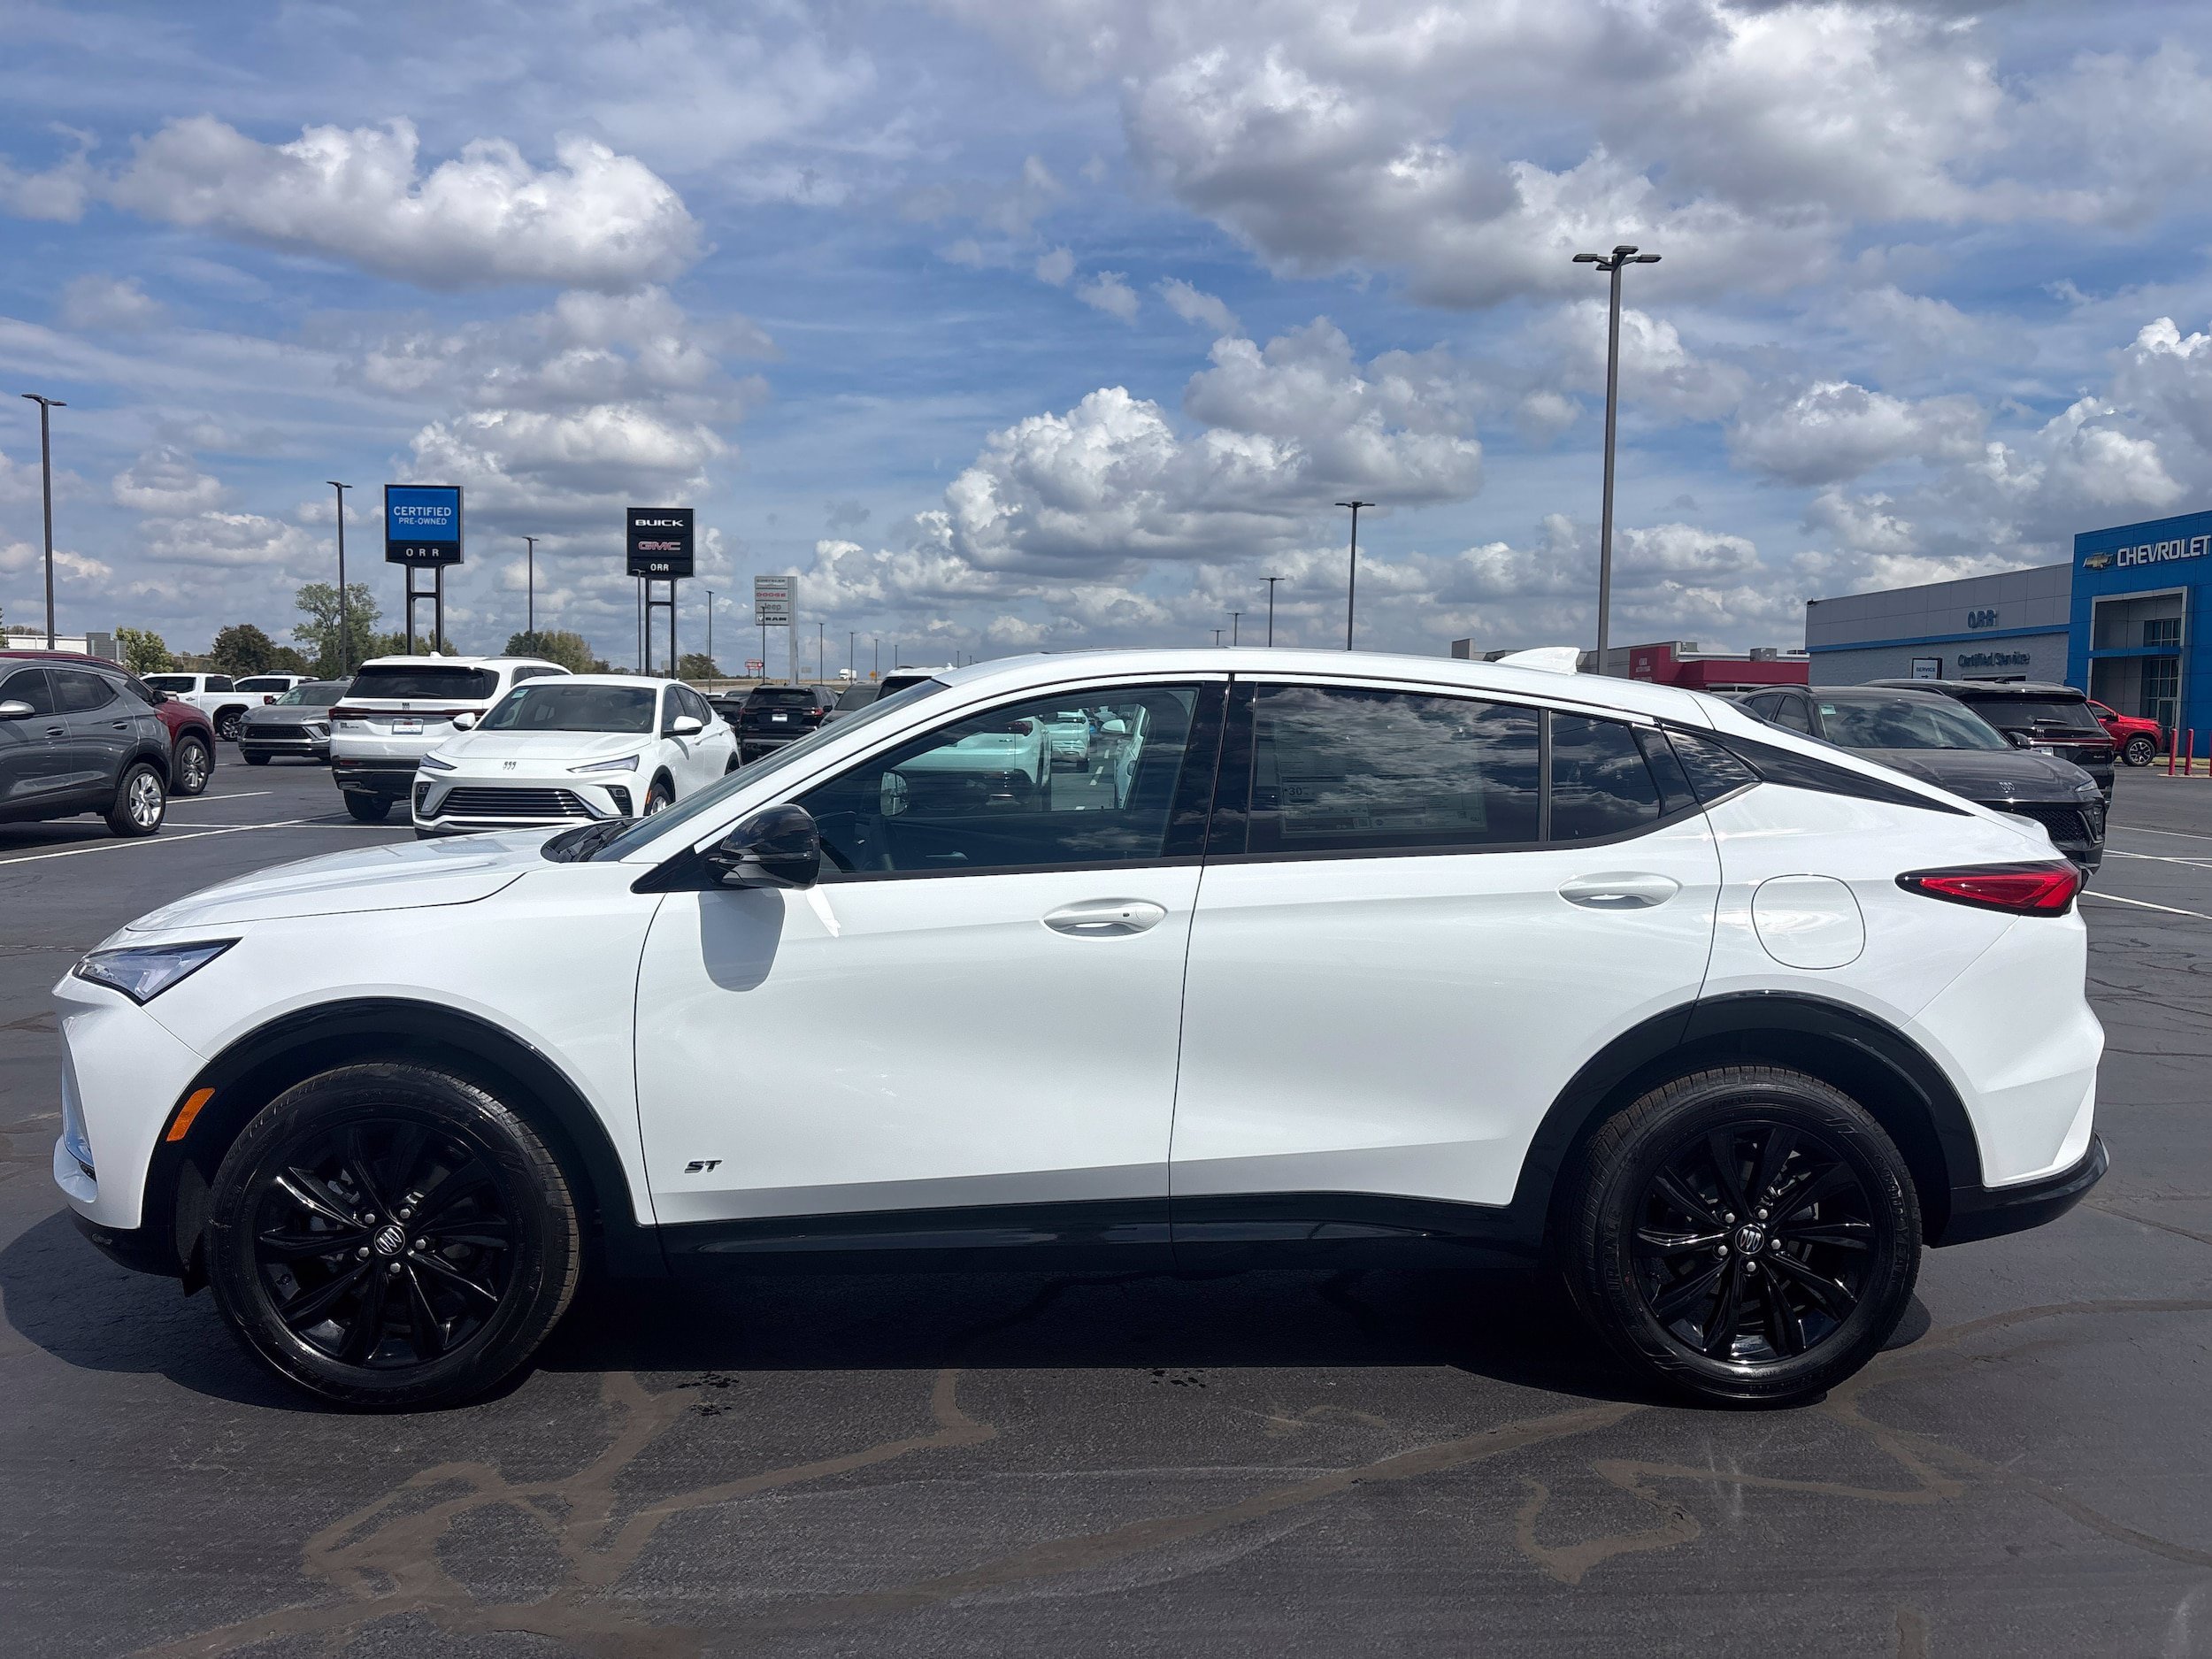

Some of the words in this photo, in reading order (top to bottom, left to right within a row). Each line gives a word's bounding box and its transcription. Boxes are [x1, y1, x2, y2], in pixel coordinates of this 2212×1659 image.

[394, 506, 452, 517] CERTIFIED
[634, 518, 685, 527] BUICK
[638, 541, 681, 551] GMC
[2116, 534, 2212, 567] CHEVROLET
[405, 548, 440, 557] ORR
[649, 563, 670, 572] ORR
[1967, 609, 1998, 629] ORR
[1958, 652, 1994, 667] Certified
[1995, 650, 2031, 665] Service
[684, 1159, 723, 1174] ST
